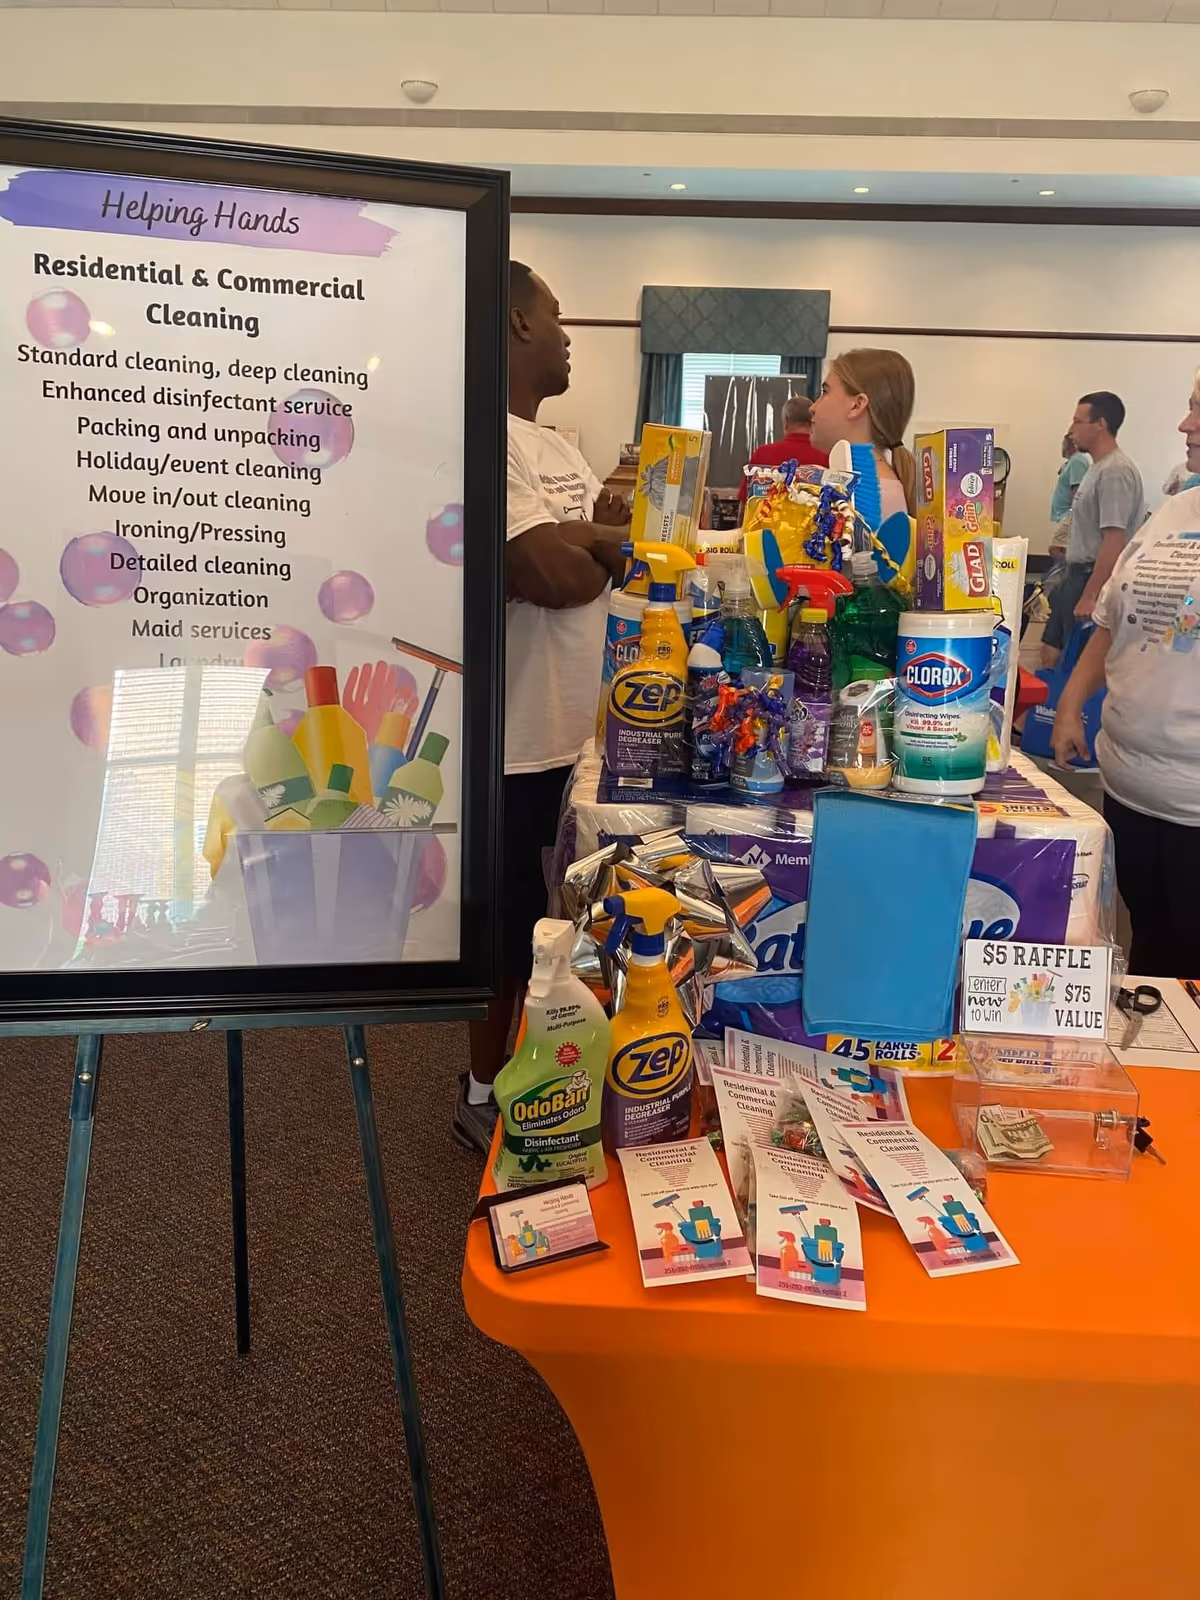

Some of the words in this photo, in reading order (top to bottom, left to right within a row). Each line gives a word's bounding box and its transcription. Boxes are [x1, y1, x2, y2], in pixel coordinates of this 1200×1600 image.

[101, 189, 208, 236] Helping
[214, 200, 301, 234] Hands
[33, 253, 183, 286] Residential
[191, 268, 209, 288] &
[216, 268, 365, 301] Commercial
[145, 303, 260, 338] Cleaning
[17, 344, 118, 369] Standard
[124, 350, 221, 379] cleaning,
[228, 359, 277, 382] deep
[283, 362, 369, 391] cleaning
[42, 379, 145, 405] Enhanced
[152, 387, 277, 414] disinfectant
[283, 398, 353, 418] service
[76, 416, 161, 443] Packing
[167, 421, 207, 441] and
[213, 426, 322, 453] unpacking
[76, 450, 229, 477] Holiday/event
[235, 458, 322, 485] cleaning
[923, 452, 932, 499] GLAD
[88, 484, 146, 505] Move
[152, 485, 218, 509] in/out
[224, 491, 311, 517] cleaning
[114, 519, 287, 548] Ironing/Pressing
[661, 515, 670, 542] RESISTS
[705, 546, 718, 554] BIG
[720, 546, 735, 554] ROLL
[110, 553, 198, 573] Detailed
[204, 556, 292, 581] cleaning
[967, 544, 985, 593] GLAD
[133, 587, 269, 609] Organization
[132, 619, 183, 638] Maid
[191, 622, 272, 641] services
[159, 652, 246, 667] Landry
[617, 645, 639, 661] CLO
[906, 666, 962, 687] CLOROX
[905, 711, 938, 719] Disinfecting
[618, 729, 662, 739] INDUSTRIAL
[618, 736, 662, 745] DEGREASER
[922, 756, 932, 765] 85
[983, 942, 1007, 966] $5
[1013, 945, 1091, 969] RAFFLE
[974, 978, 1002, 992] enter
[1064, 983, 1091, 1004] $75
[559, 1004, 581, 1012] 99.99%
[968, 995, 1006, 1007] now
[971, 1009, 981, 1021] to
[983, 1008, 1001, 1023] win
[1055, 1009, 1103, 1029] VALUE
[547, 1018, 586, 1032] Multi-Purpose
[832, 1038, 872, 1061] 45
[875, 1041, 918, 1051] LARGE
[741, 1045, 751, 1073] esidential
[766, 1051, 776, 1076] Cleaning
[723, 1080, 768, 1097] Residential
[514, 1088, 587, 1121] OdoBan
[625, 1097, 671, 1114] INDUSTRIAL
[728, 1090, 777, 1107] Commercial
[522, 1114, 562, 1130] Eliminates
[563, 1105, 585, 1118] Odors
[625, 1103, 671, 1121] DEGREASER
[737, 1101, 774, 1117] Cleaning
[524, 1133, 580, 1147] Disinfectant
[866, 1137, 919, 1145] Commercial
[879, 1144, 920, 1152] Cleaning
[568, 1151, 588, 1159] Original
[635, 1146, 688, 1158] Residential
[640, 1151, 697, 1163] Commercial
[767, 1151, 820, 1167] Residential
[556, 1157, 588, 1167] EUCALYPTUS
[649, 1157, 692, 1167] Cleaning
[771, 1157, 829, 1174] Commercial
[780, 1165, 824, 1180] Cleaning
